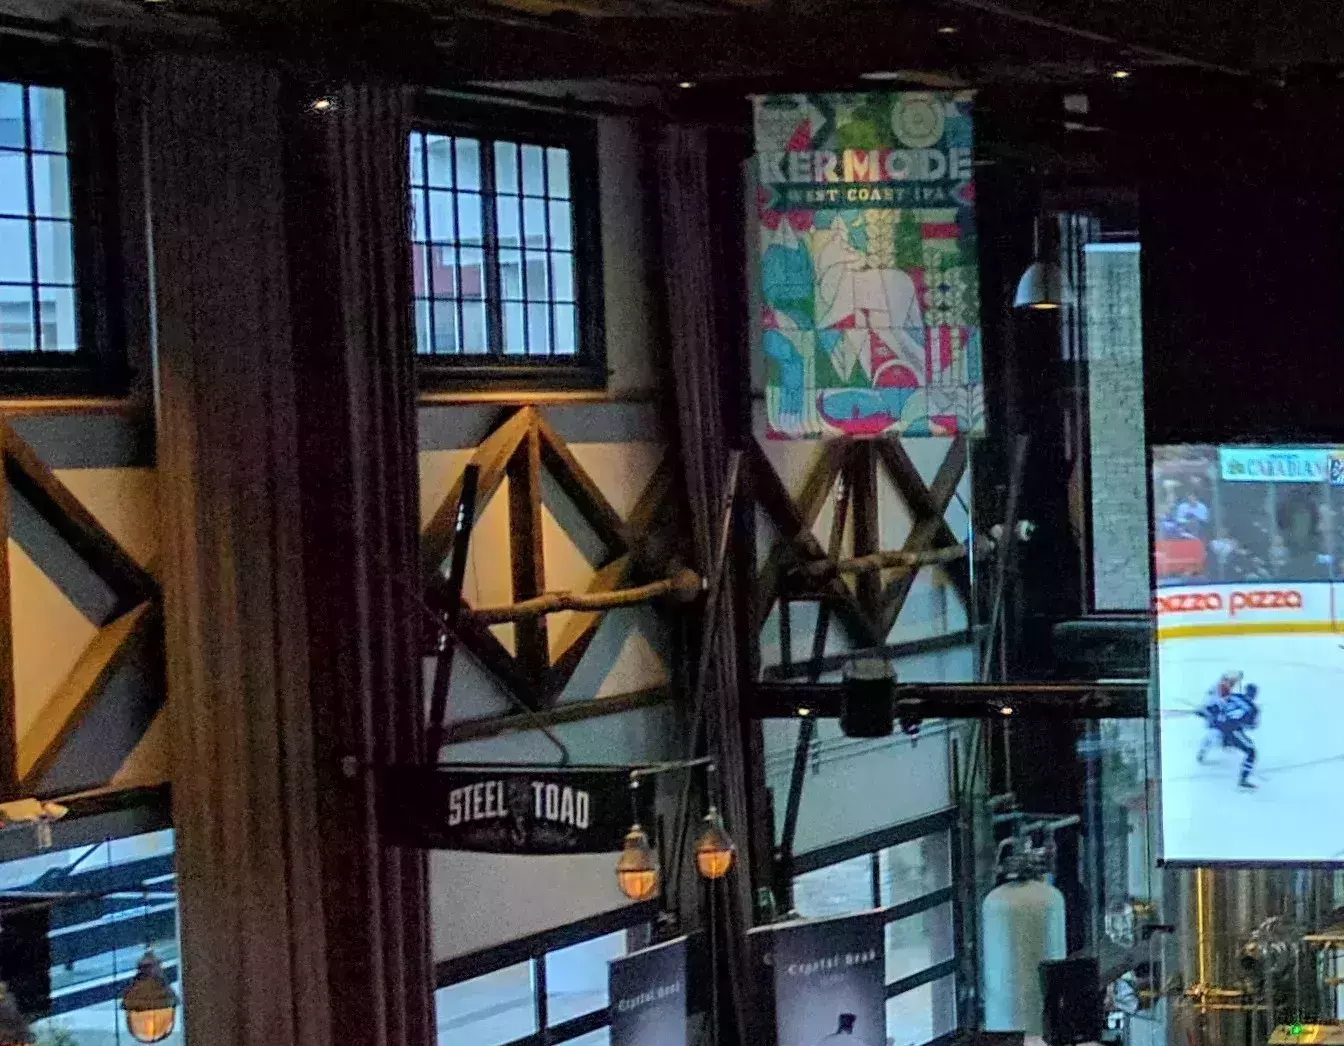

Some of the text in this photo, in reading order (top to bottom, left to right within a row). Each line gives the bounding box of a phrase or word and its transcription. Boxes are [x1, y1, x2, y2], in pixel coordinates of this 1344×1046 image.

[758, 148, 972, 183] KERMODE
[787, 186, 944, 203] WEST COAST IPA
[448, 780, 590, 829] STEEL TOAD
